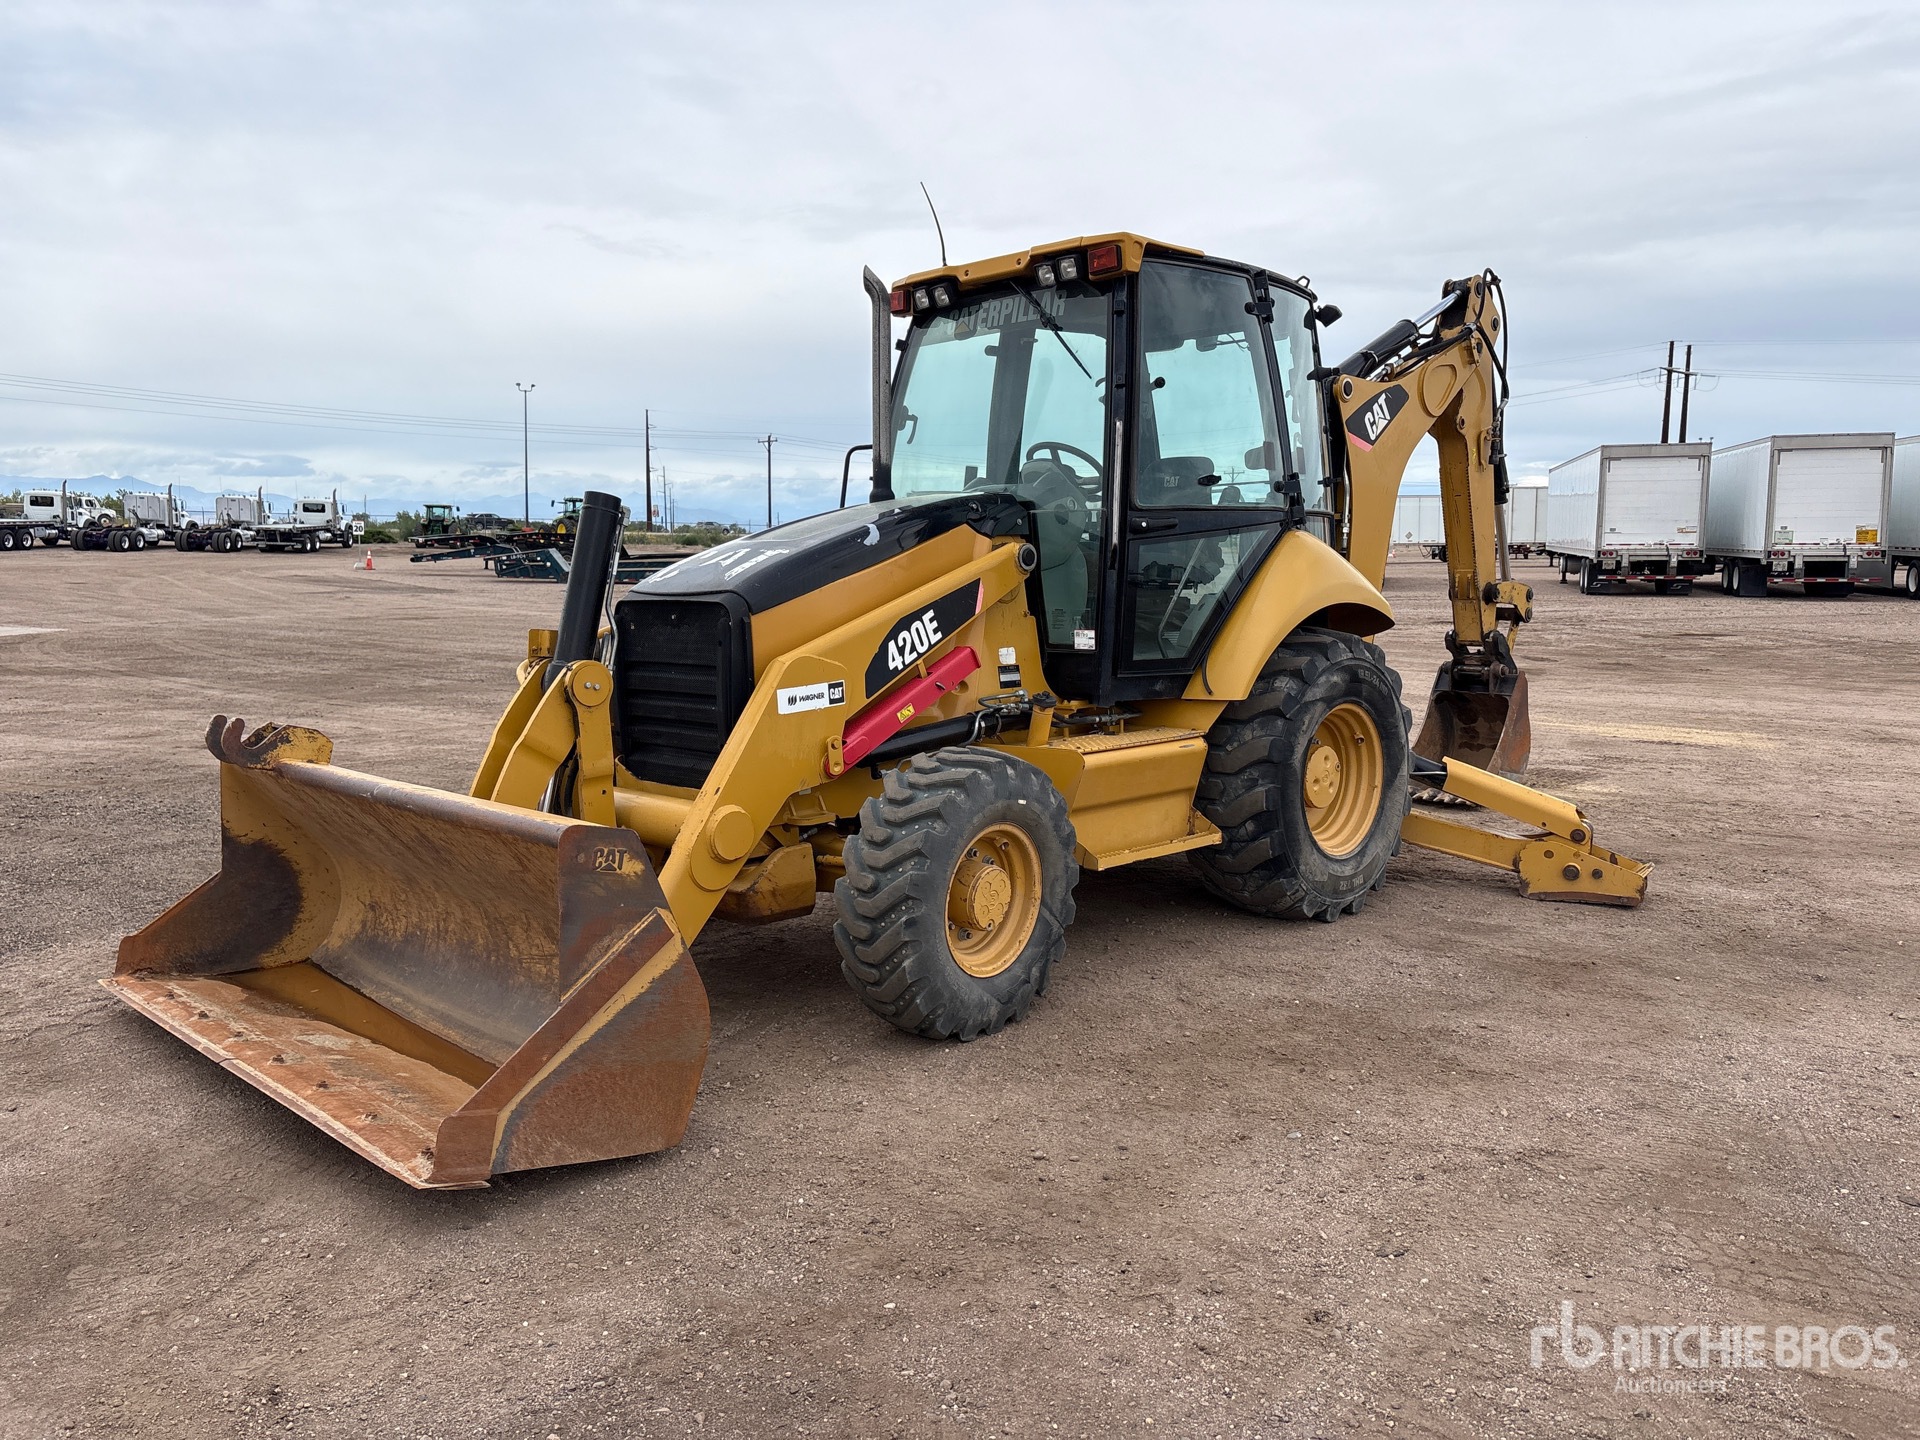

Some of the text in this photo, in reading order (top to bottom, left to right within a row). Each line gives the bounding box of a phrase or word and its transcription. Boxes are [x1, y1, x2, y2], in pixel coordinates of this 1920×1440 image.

[948, 290, 1067, 332] CATERPILLAR
[1364, 392, 1391, 440] CAT
[1163, 475, 1180, 488] CAT
[353, 525, 364, 533] 20
[888, 609, 942, 671] 420E
[799, 687, 843, 702] WAGNER CAT
[592, 847, 627, 871] CAT
